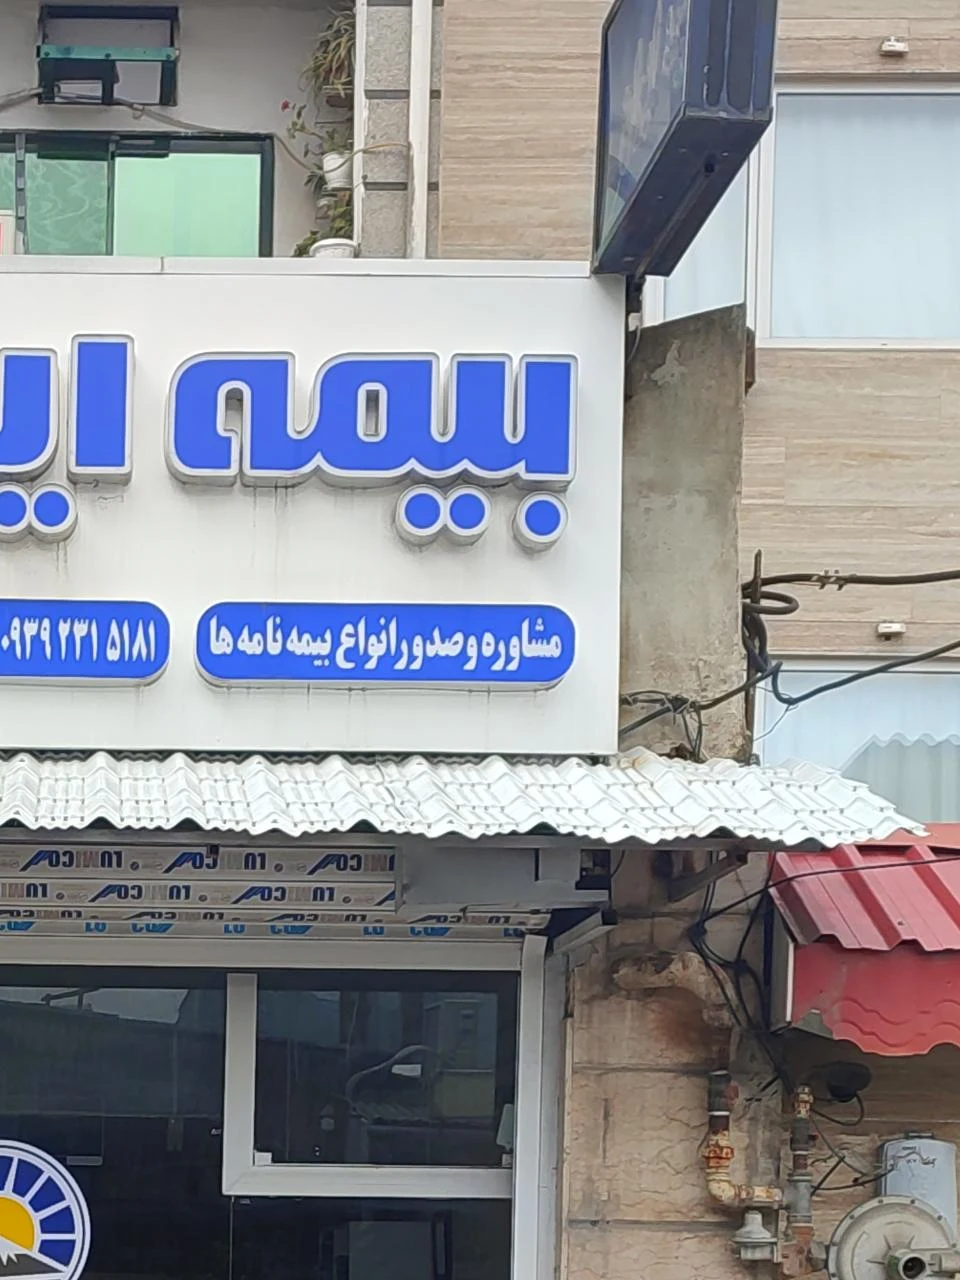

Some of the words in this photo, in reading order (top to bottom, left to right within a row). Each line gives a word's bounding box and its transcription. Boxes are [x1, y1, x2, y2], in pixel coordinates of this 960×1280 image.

[167, 351, 579, 545] بیمه
[286, 625, 333, 667] بیمه
[335, 616, 397, 669] انواع
[393, 626, 464, 671] صدور
[481, 616, 562, 672] مشاوره
